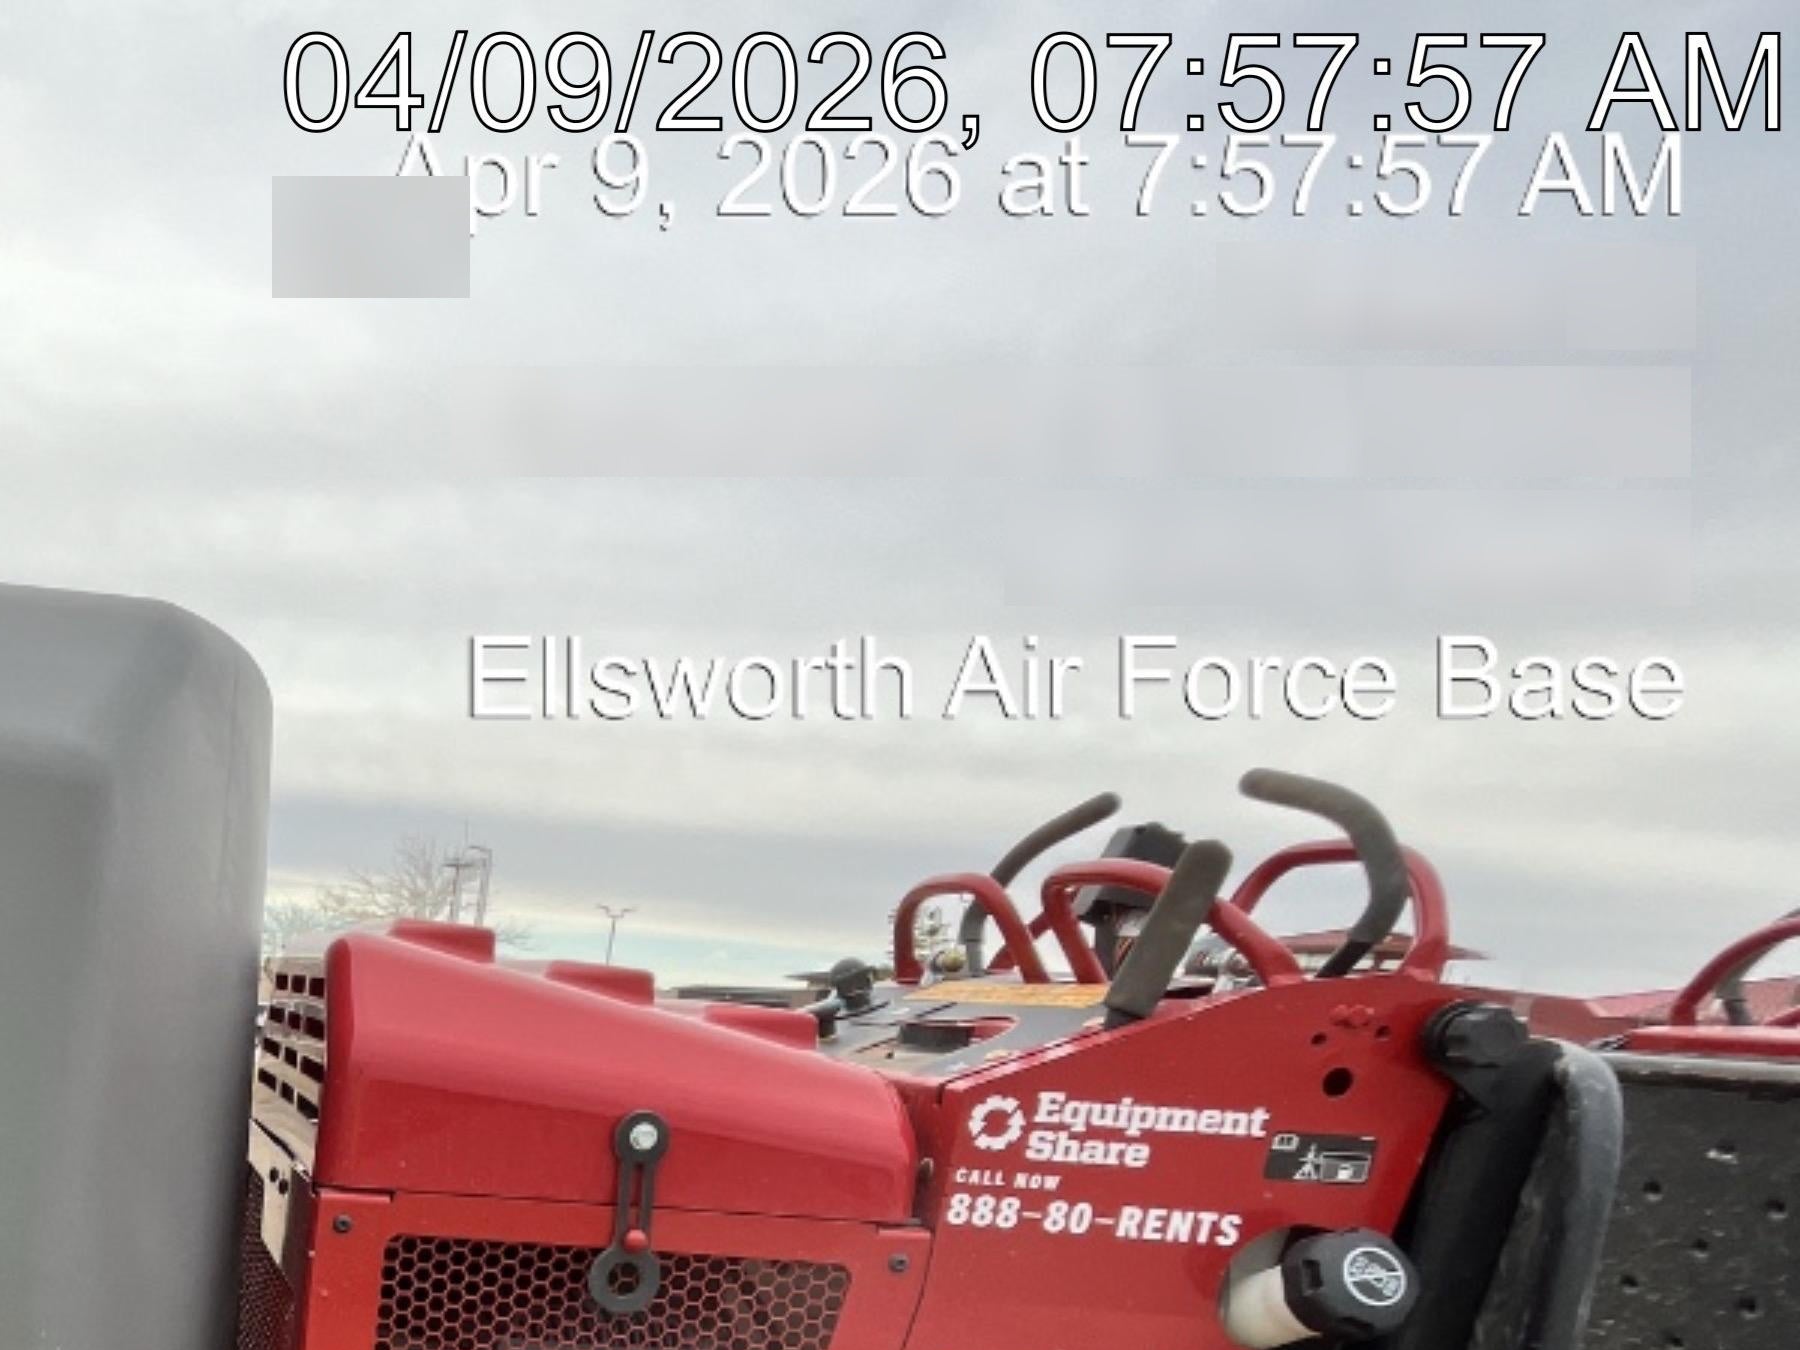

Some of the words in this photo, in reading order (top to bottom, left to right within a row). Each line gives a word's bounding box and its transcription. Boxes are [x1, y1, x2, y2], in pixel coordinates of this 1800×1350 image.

[1034, 1091, 1270, 1137] Equipment
[1024, 1130, 1151, 1170] Share
[954, 1167, 1006, 1189] CALL
[1013, 1172, 1062, 1193] NOW
[946, 1193, 1242, 1247] 888-80-RENTS
